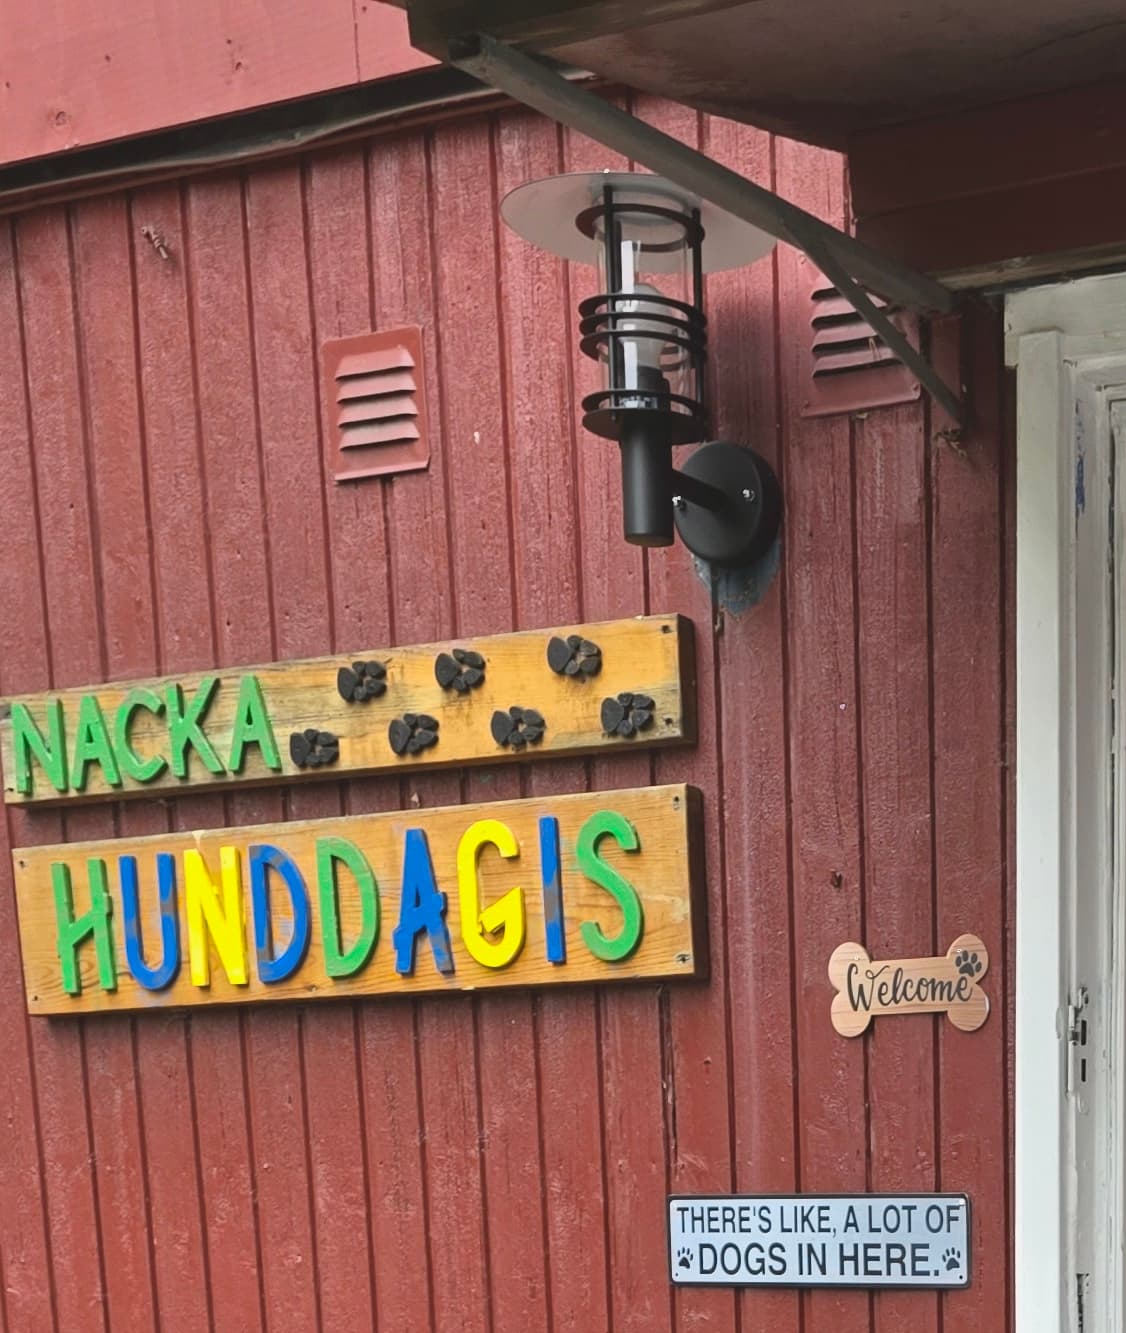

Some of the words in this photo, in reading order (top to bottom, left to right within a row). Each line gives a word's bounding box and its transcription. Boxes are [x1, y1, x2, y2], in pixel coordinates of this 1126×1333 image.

[10, 673, 282, 796] NACKA
[51, 810, 644, 996] HUNDDAGIS
[846, 962, 973, 1012] Welcome
[676, 1205, 772, 1234] THERE'S
[780, 1205, 837, 1238] LIKE,
[843, 1204, 860, 1233] A
[868, 1204, 918, 1233] LOT
[925, 1204, 961, 1234] OF
[698, 1242, 787, 1276] DOGS
[797, 1242, 827, 1276] IN
[838, 1242, 940, 1277] HERE.
